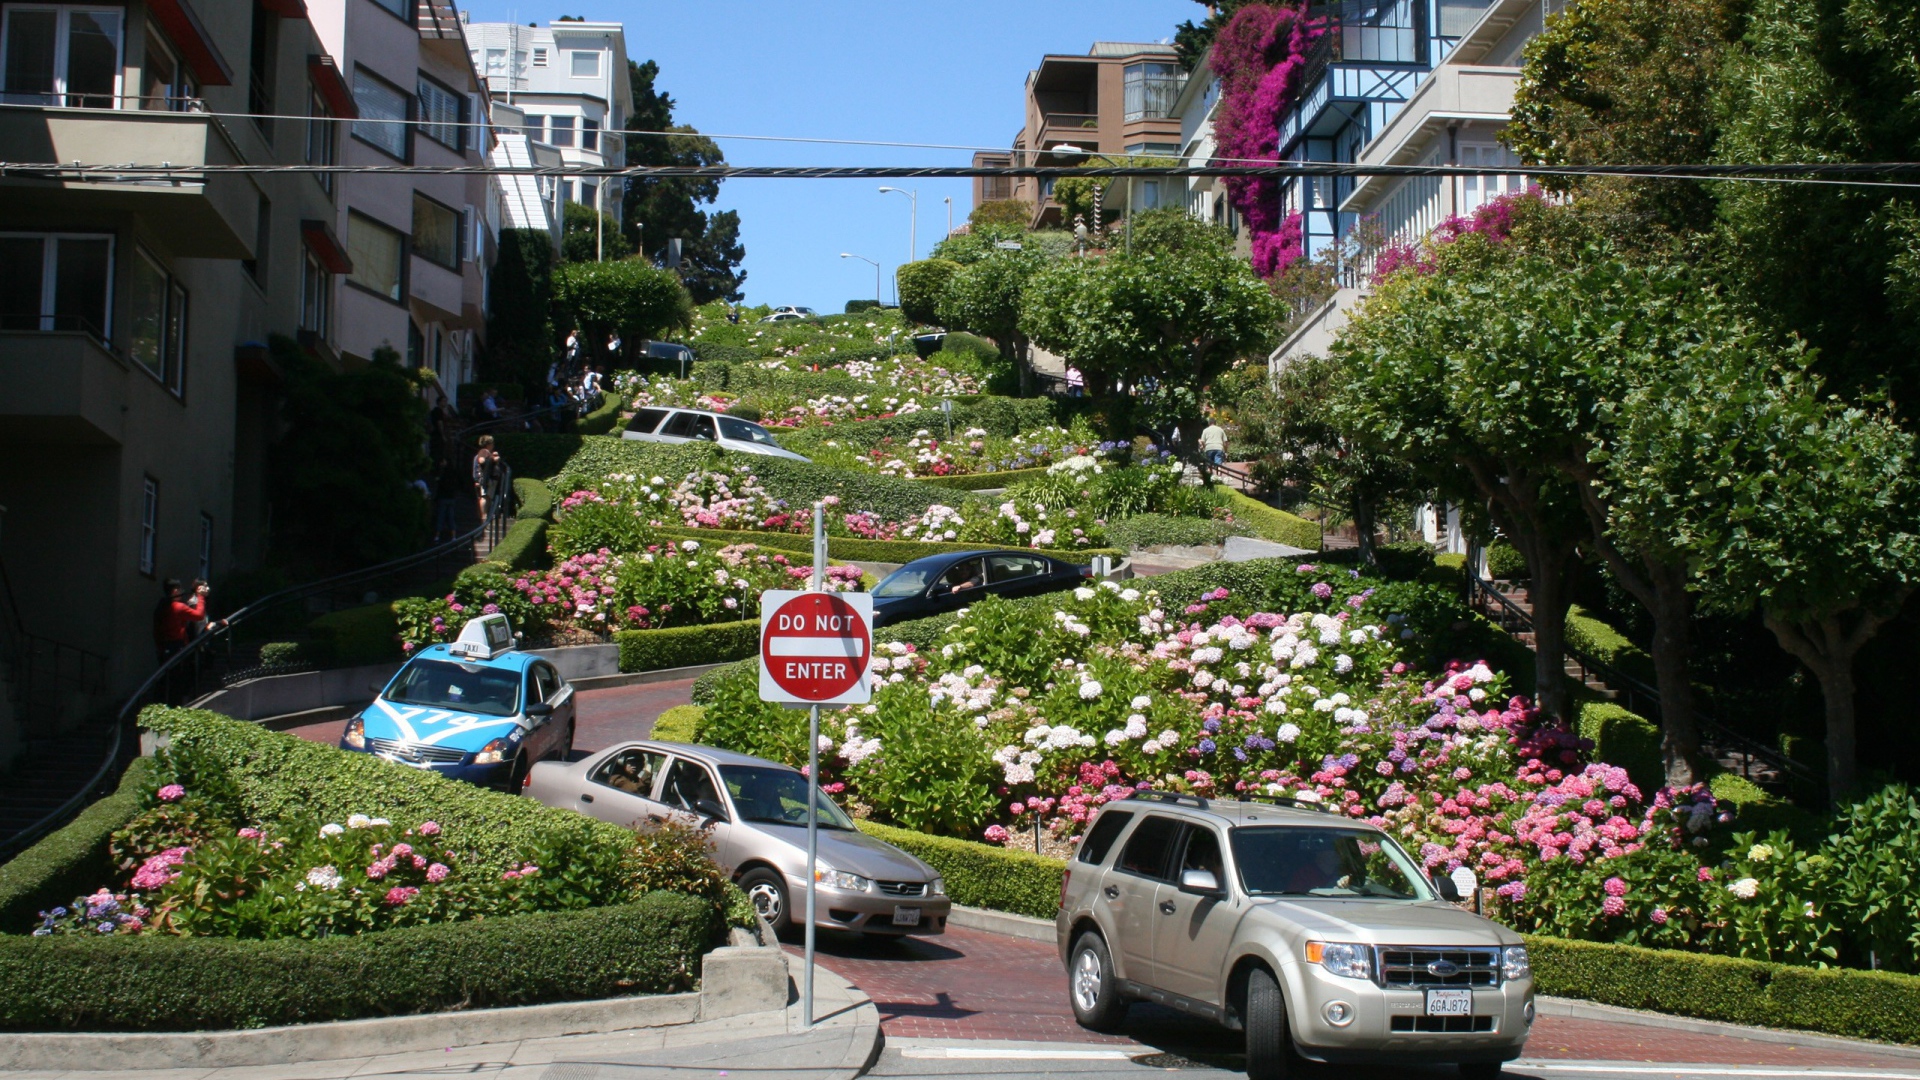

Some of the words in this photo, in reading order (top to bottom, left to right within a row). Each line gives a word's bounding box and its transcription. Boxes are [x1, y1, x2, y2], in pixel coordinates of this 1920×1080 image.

[779, 614, 805, 631] DO
[815, 615, 854, 631] NOT
[463, 643, 479, 653] TAXI
[785, 662, 846, 679] ENTER
[401, 707, 479, 726] 774
[1430, 999, 1469, 1012] 6GAJ872
